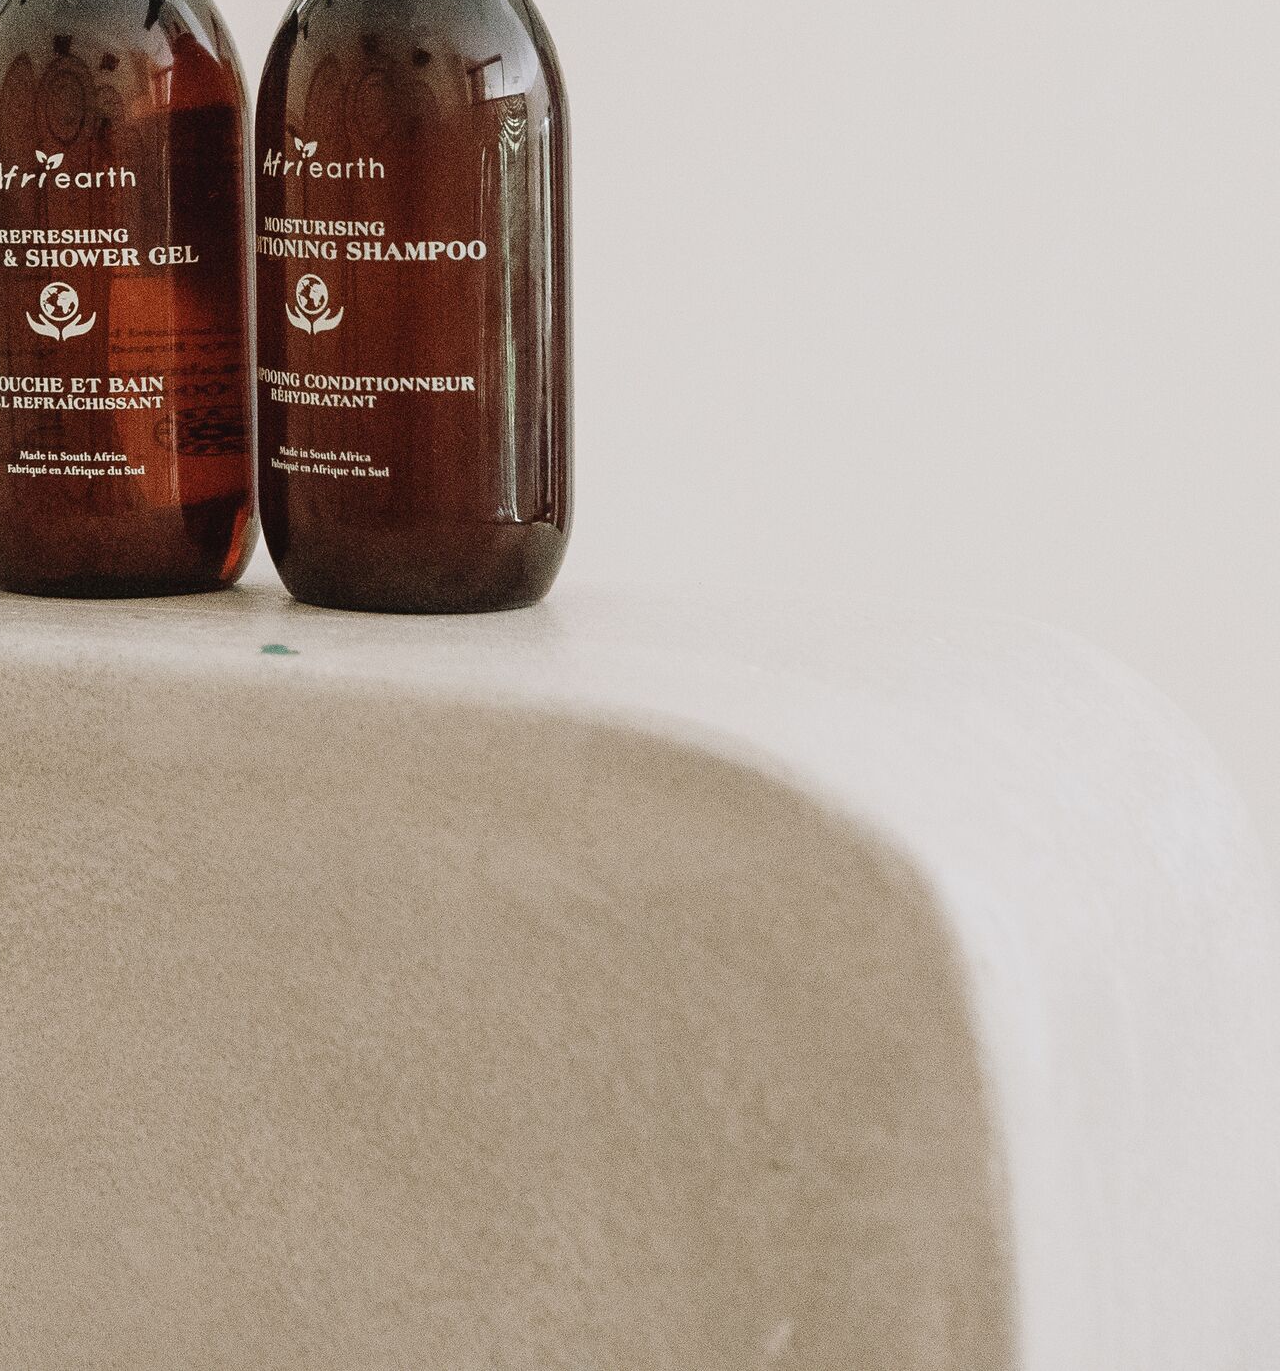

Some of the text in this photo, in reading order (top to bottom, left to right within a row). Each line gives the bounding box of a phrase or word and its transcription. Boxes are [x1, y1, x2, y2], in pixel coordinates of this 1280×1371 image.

[264, 216, 385, 237] MOISTURISING
[3, 248, 18, 267] &
[25, 248, 140, 268] SHOWER
[148, 245, 200, 266] GEL
[346, 240, 487, 261] SHAMPOO
[71, 377, 102, 393] ET
[109, 376, 164, 393] BAIN
[304, 374, 476, 392] CONDITIONNEUR
[13, 394, 164, 410] REFRAÎCHISSANT
[271, 386, 377, 408] RÉHYDRATANT
[19, 450, 127, 462] Made in South Africa
[279, 445, 371, 462] Made in South Africa
[7, 463, 145, 478] Fabriqué en Afrique du Sud
[271, 458, 390, 478] Fabriqué en Afrique du Sud
